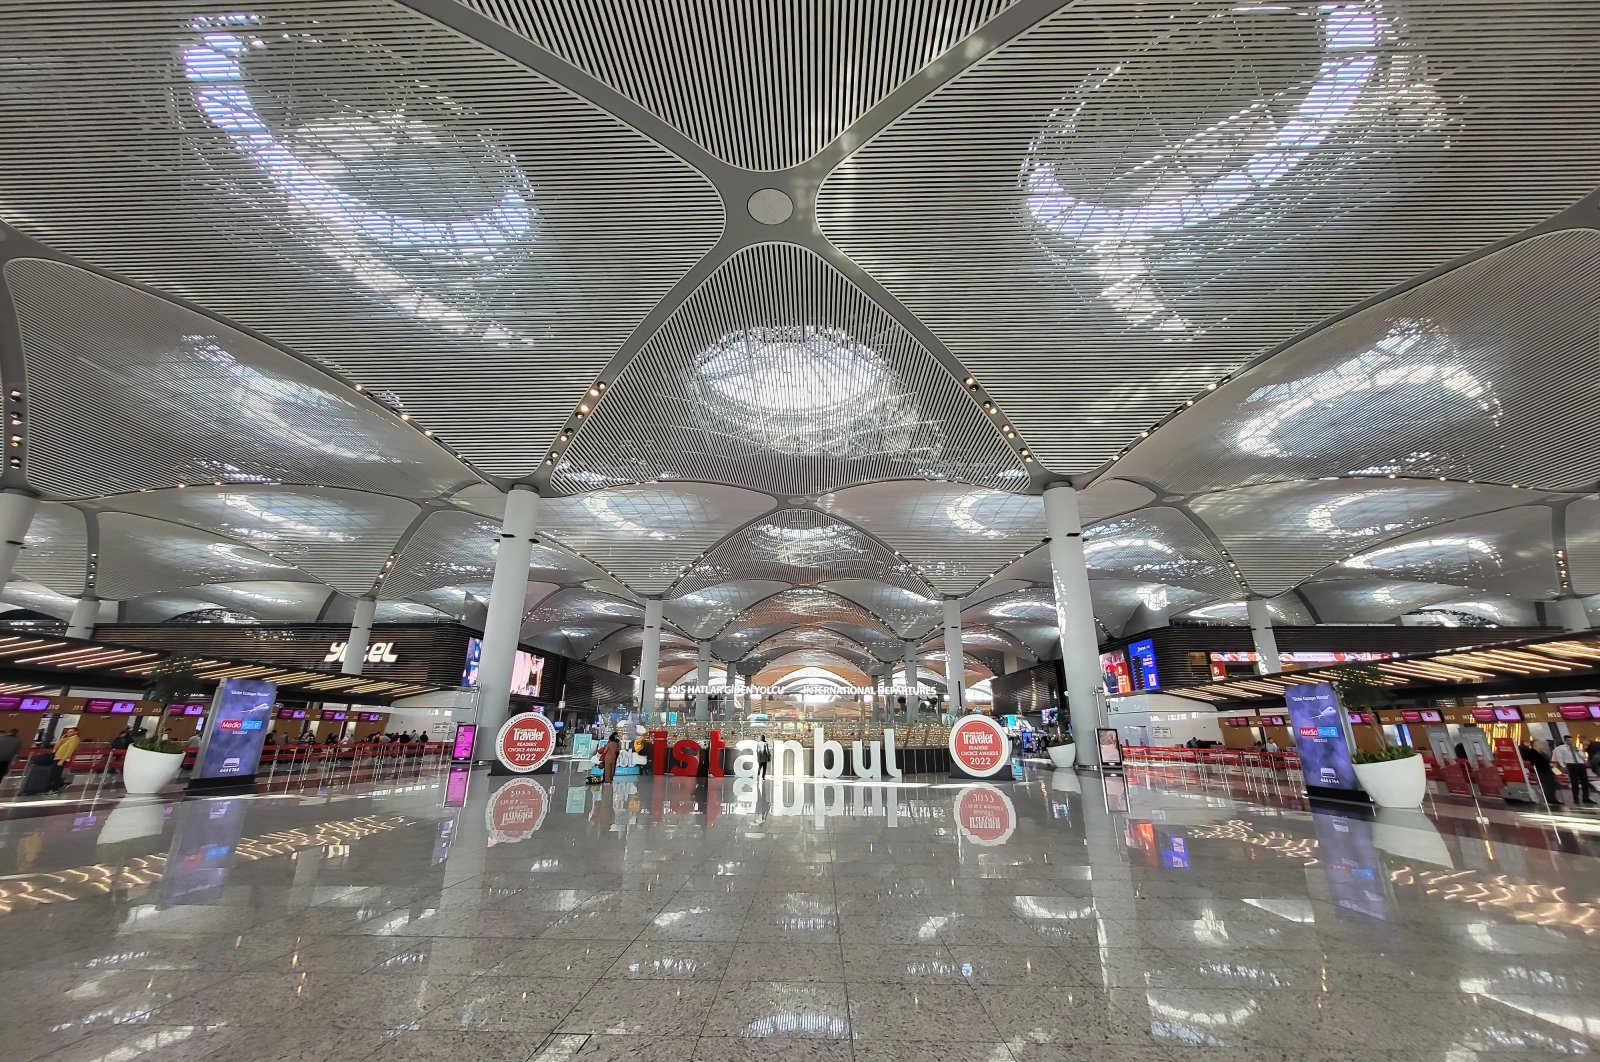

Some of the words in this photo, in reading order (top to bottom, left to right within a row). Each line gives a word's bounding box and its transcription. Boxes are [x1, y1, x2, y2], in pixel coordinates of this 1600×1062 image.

[688, 685, 722, 694] HATLAR
[754, 686, 784, 694] YOLCU
[804, 686, 876, 695] INTERNATIONAL
[878, 686, 936, 695] DEPARTURES
[514, 727, 545, 741] Traveler
[961, 731, 993, 744] Traveler
[515, 753, 536, 761] 2022
[650, 728, 902, 780] istanbul
[970, 757, 991, 765] 2022
